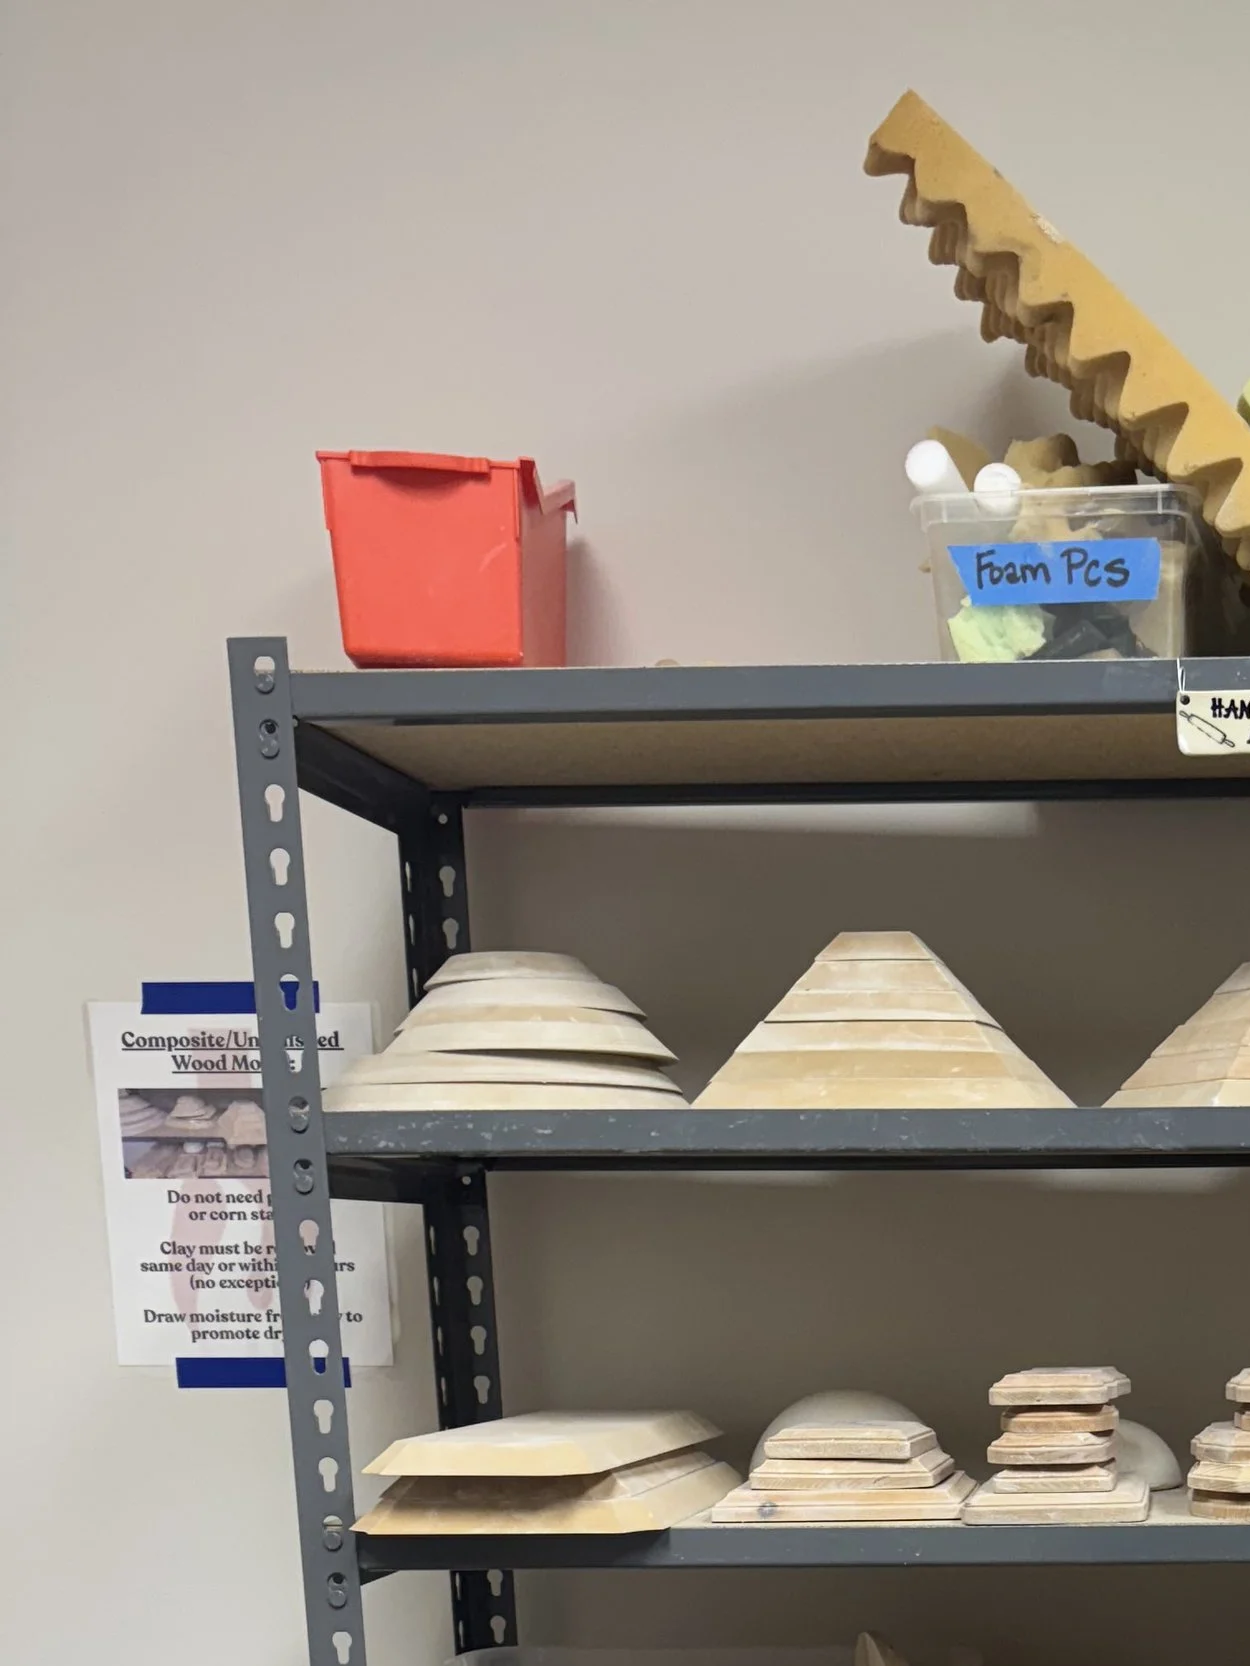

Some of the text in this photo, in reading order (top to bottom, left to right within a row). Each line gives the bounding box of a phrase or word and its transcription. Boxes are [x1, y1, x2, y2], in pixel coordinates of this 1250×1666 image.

[976, 547, 1130, 590] Foam Pcs
[172, 1054, 227, 1071] Wood
[167, 1190, 190, 1204] Do
[193, 1191, 223, 1204] not
[225, 1189, 263, 1204] need
[188, 1211, 207, 1221] or
[209, 1210, 247, 1221] corn
[160, 1241, 196, 1258] Clay
[199, 1244, 240, 1256] must
[243, 1241, 262, 1255] be
[140, 1262, 182, 1272] same
[186, 1259, 215, 1275] day
[217, 1262, 236, 1272] or
[238, 1259, 278, 1272] withi
[189, 1275, 216, 1291] (no
[144, 1309, 187, 1323] Draw
[189, 1309, 262, 1323] moisture
[345, 1311, 363, 1323] to
[191, 1327, 260, 1343] promote
